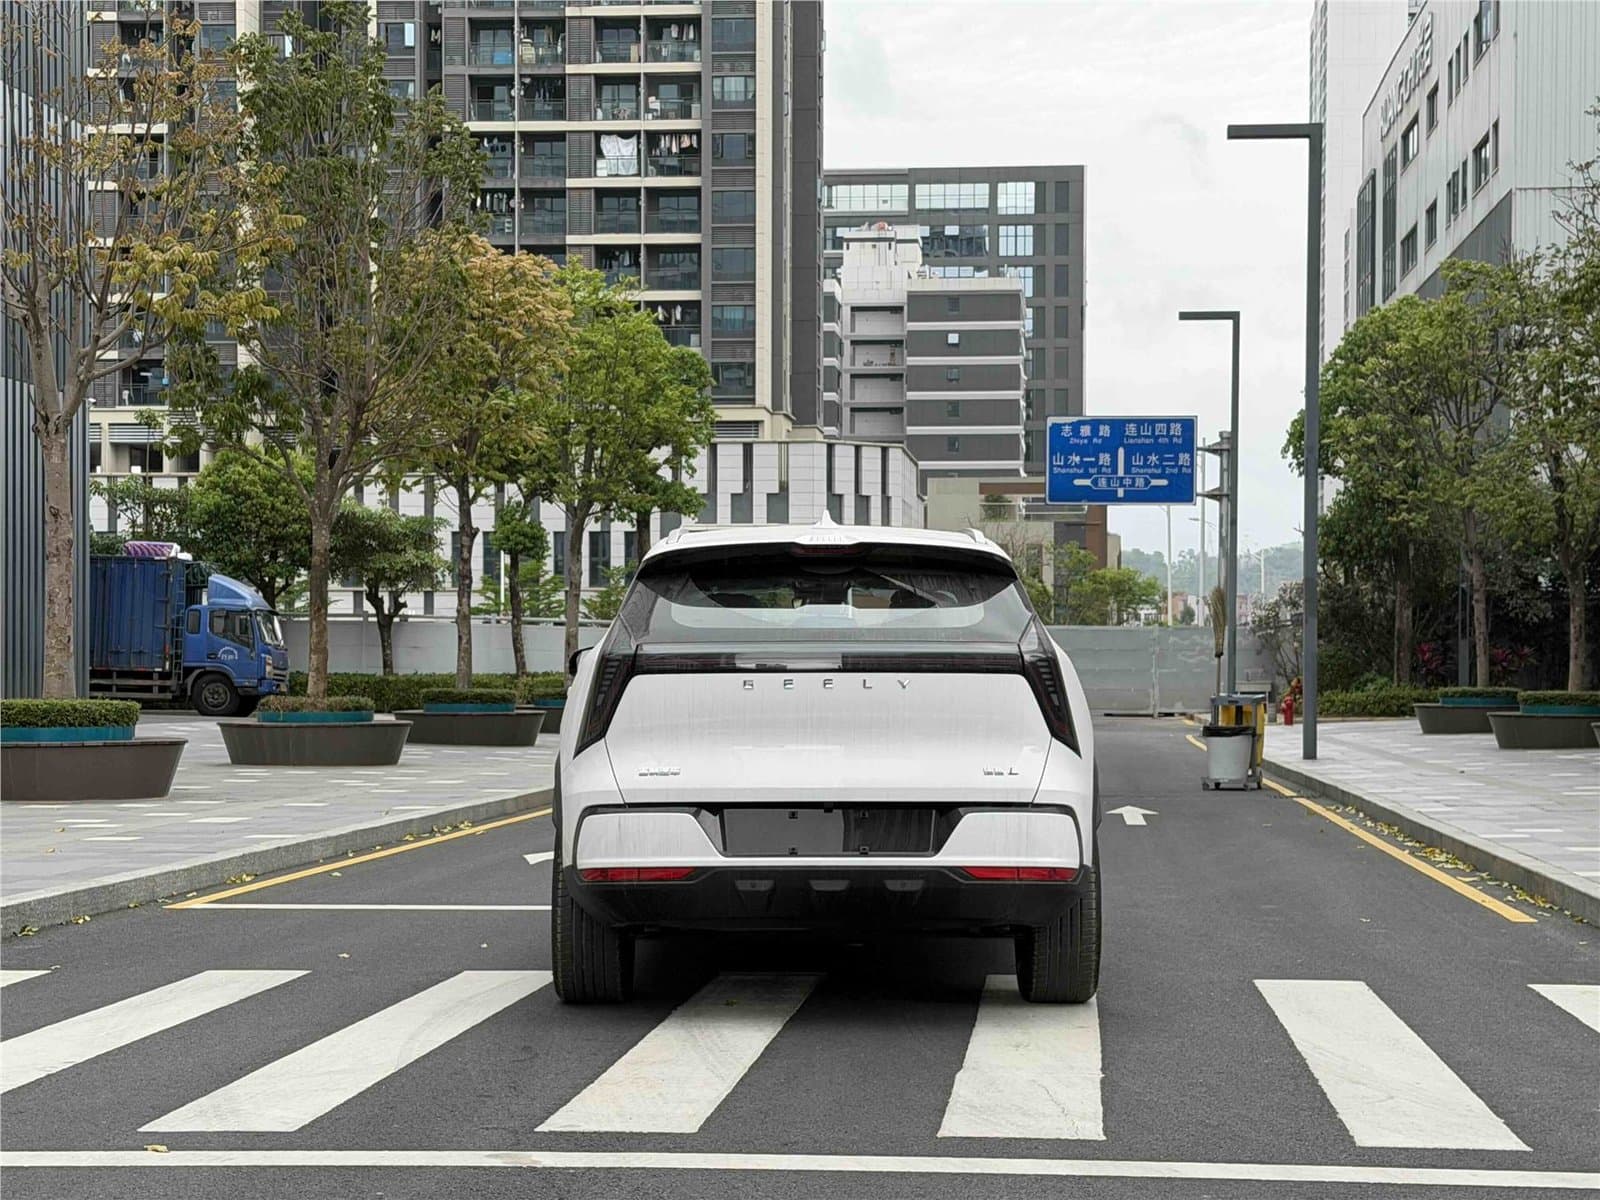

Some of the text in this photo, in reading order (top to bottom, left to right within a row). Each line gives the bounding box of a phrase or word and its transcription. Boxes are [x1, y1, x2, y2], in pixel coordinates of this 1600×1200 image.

[1061, 424, 1111, 437] 志雅路
[1124, 423, 1182, 436] 连山四路
[1052, 452, 1111, 466] 山水一路
[1131, 452, 1191, 466] 山水二路
[1097, 477, 1146, 488] 连山中路
[743, 679, 911, 690] GEELY
